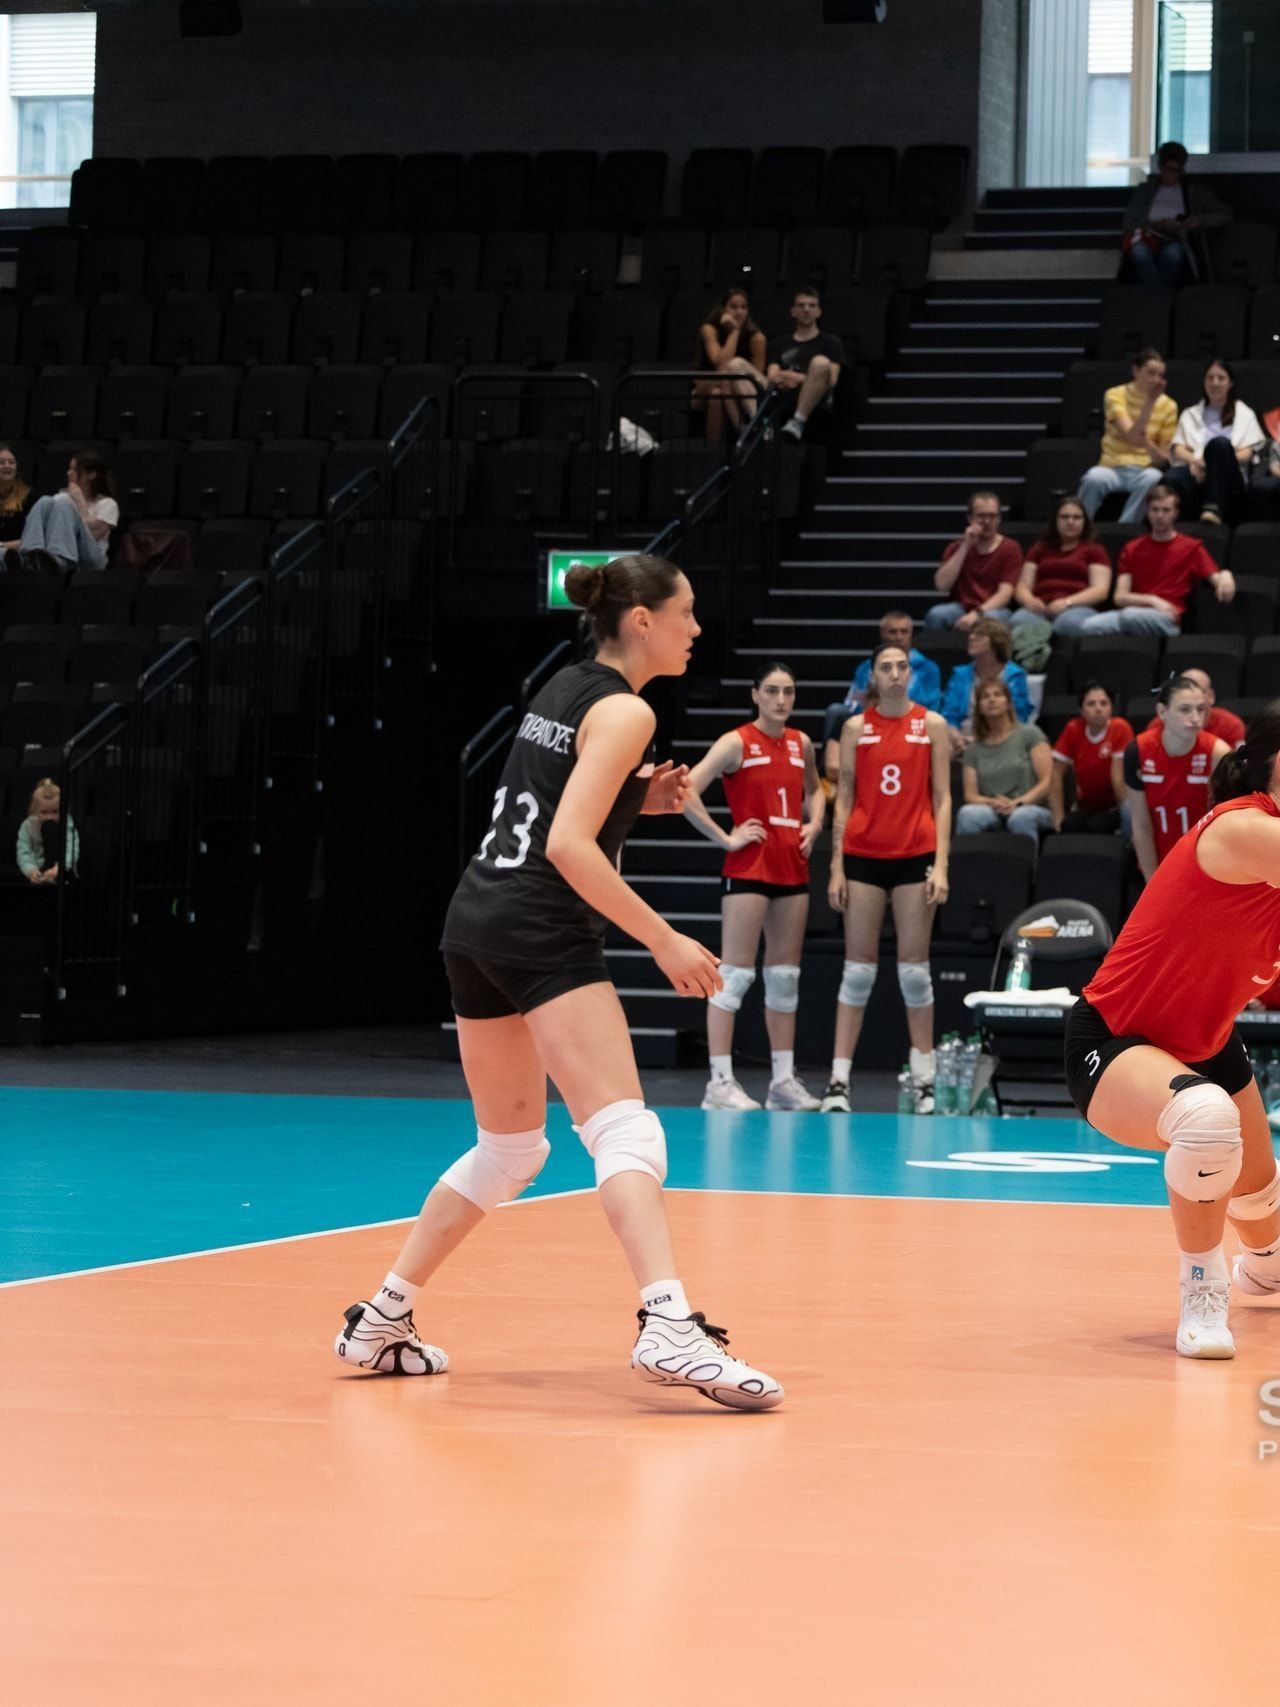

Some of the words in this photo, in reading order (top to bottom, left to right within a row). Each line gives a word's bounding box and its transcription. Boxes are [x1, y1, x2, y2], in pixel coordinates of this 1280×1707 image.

[880, 764, 902, 795] 8
[777, 787, 788, 818] 1
[477, 786, 539, 868] 13
[1155, 806, 1189, 834] 11
[1084, 1049, 1101, 1076] 3
